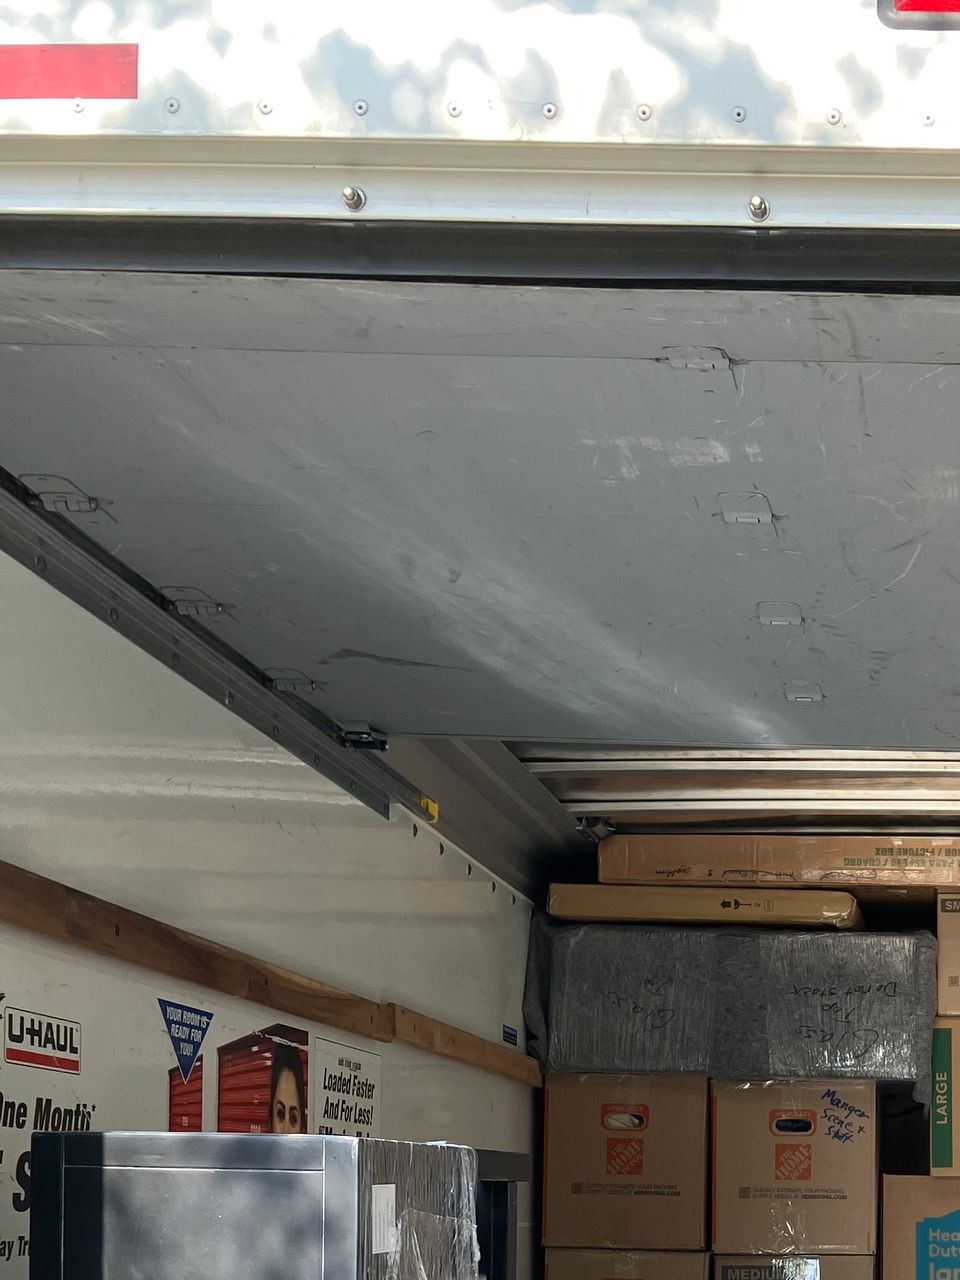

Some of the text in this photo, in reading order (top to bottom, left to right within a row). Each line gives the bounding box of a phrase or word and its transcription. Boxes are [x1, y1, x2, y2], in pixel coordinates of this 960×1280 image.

[896, 848, 935, 856] PICTURE
[790, 982, 897, 1000] Do not stack
[166, 1006, 208, 1029] YOUR ROOM IS
[8, 1013, 79, 1055] U-HAUL
[171, 1024, 203, 1043] READY FOR
[795, 1025, 879, 1060] Glass
[180, 1042, 194, 1057] YOU!
[323, 1067, 376, 1100] Loaded Faster
[323, 1096, 374, 1126] And For Less!
[936, 1072, 948, 1125] LARGE
